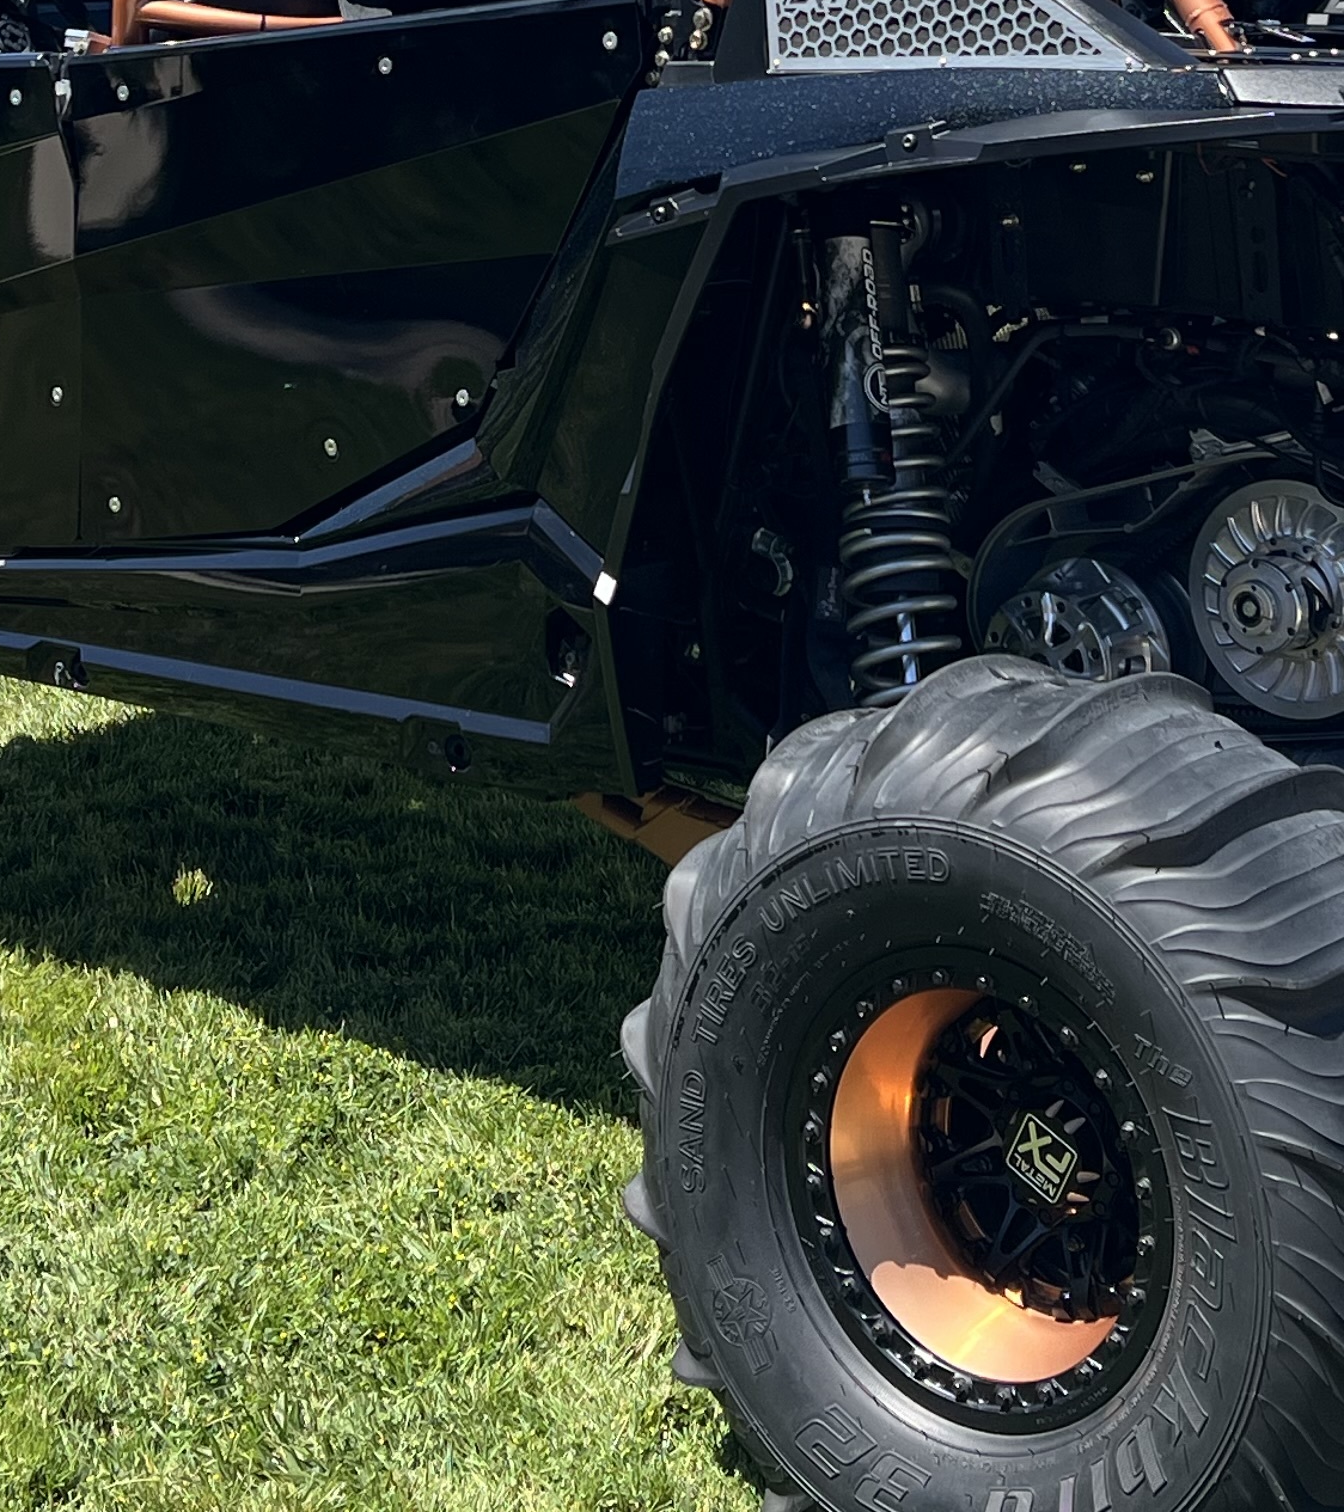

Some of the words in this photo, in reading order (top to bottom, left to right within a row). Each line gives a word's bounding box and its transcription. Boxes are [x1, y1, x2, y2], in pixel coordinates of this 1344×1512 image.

[759, 846, 952, 933] UNLIMITED
[690, 933, 758, 1046] TIRES
[1133, 1033, 1193, 1088] The
[678, 1070, 706, 1193] SAND
[1013, 1152, 1057, 1198] METAL
